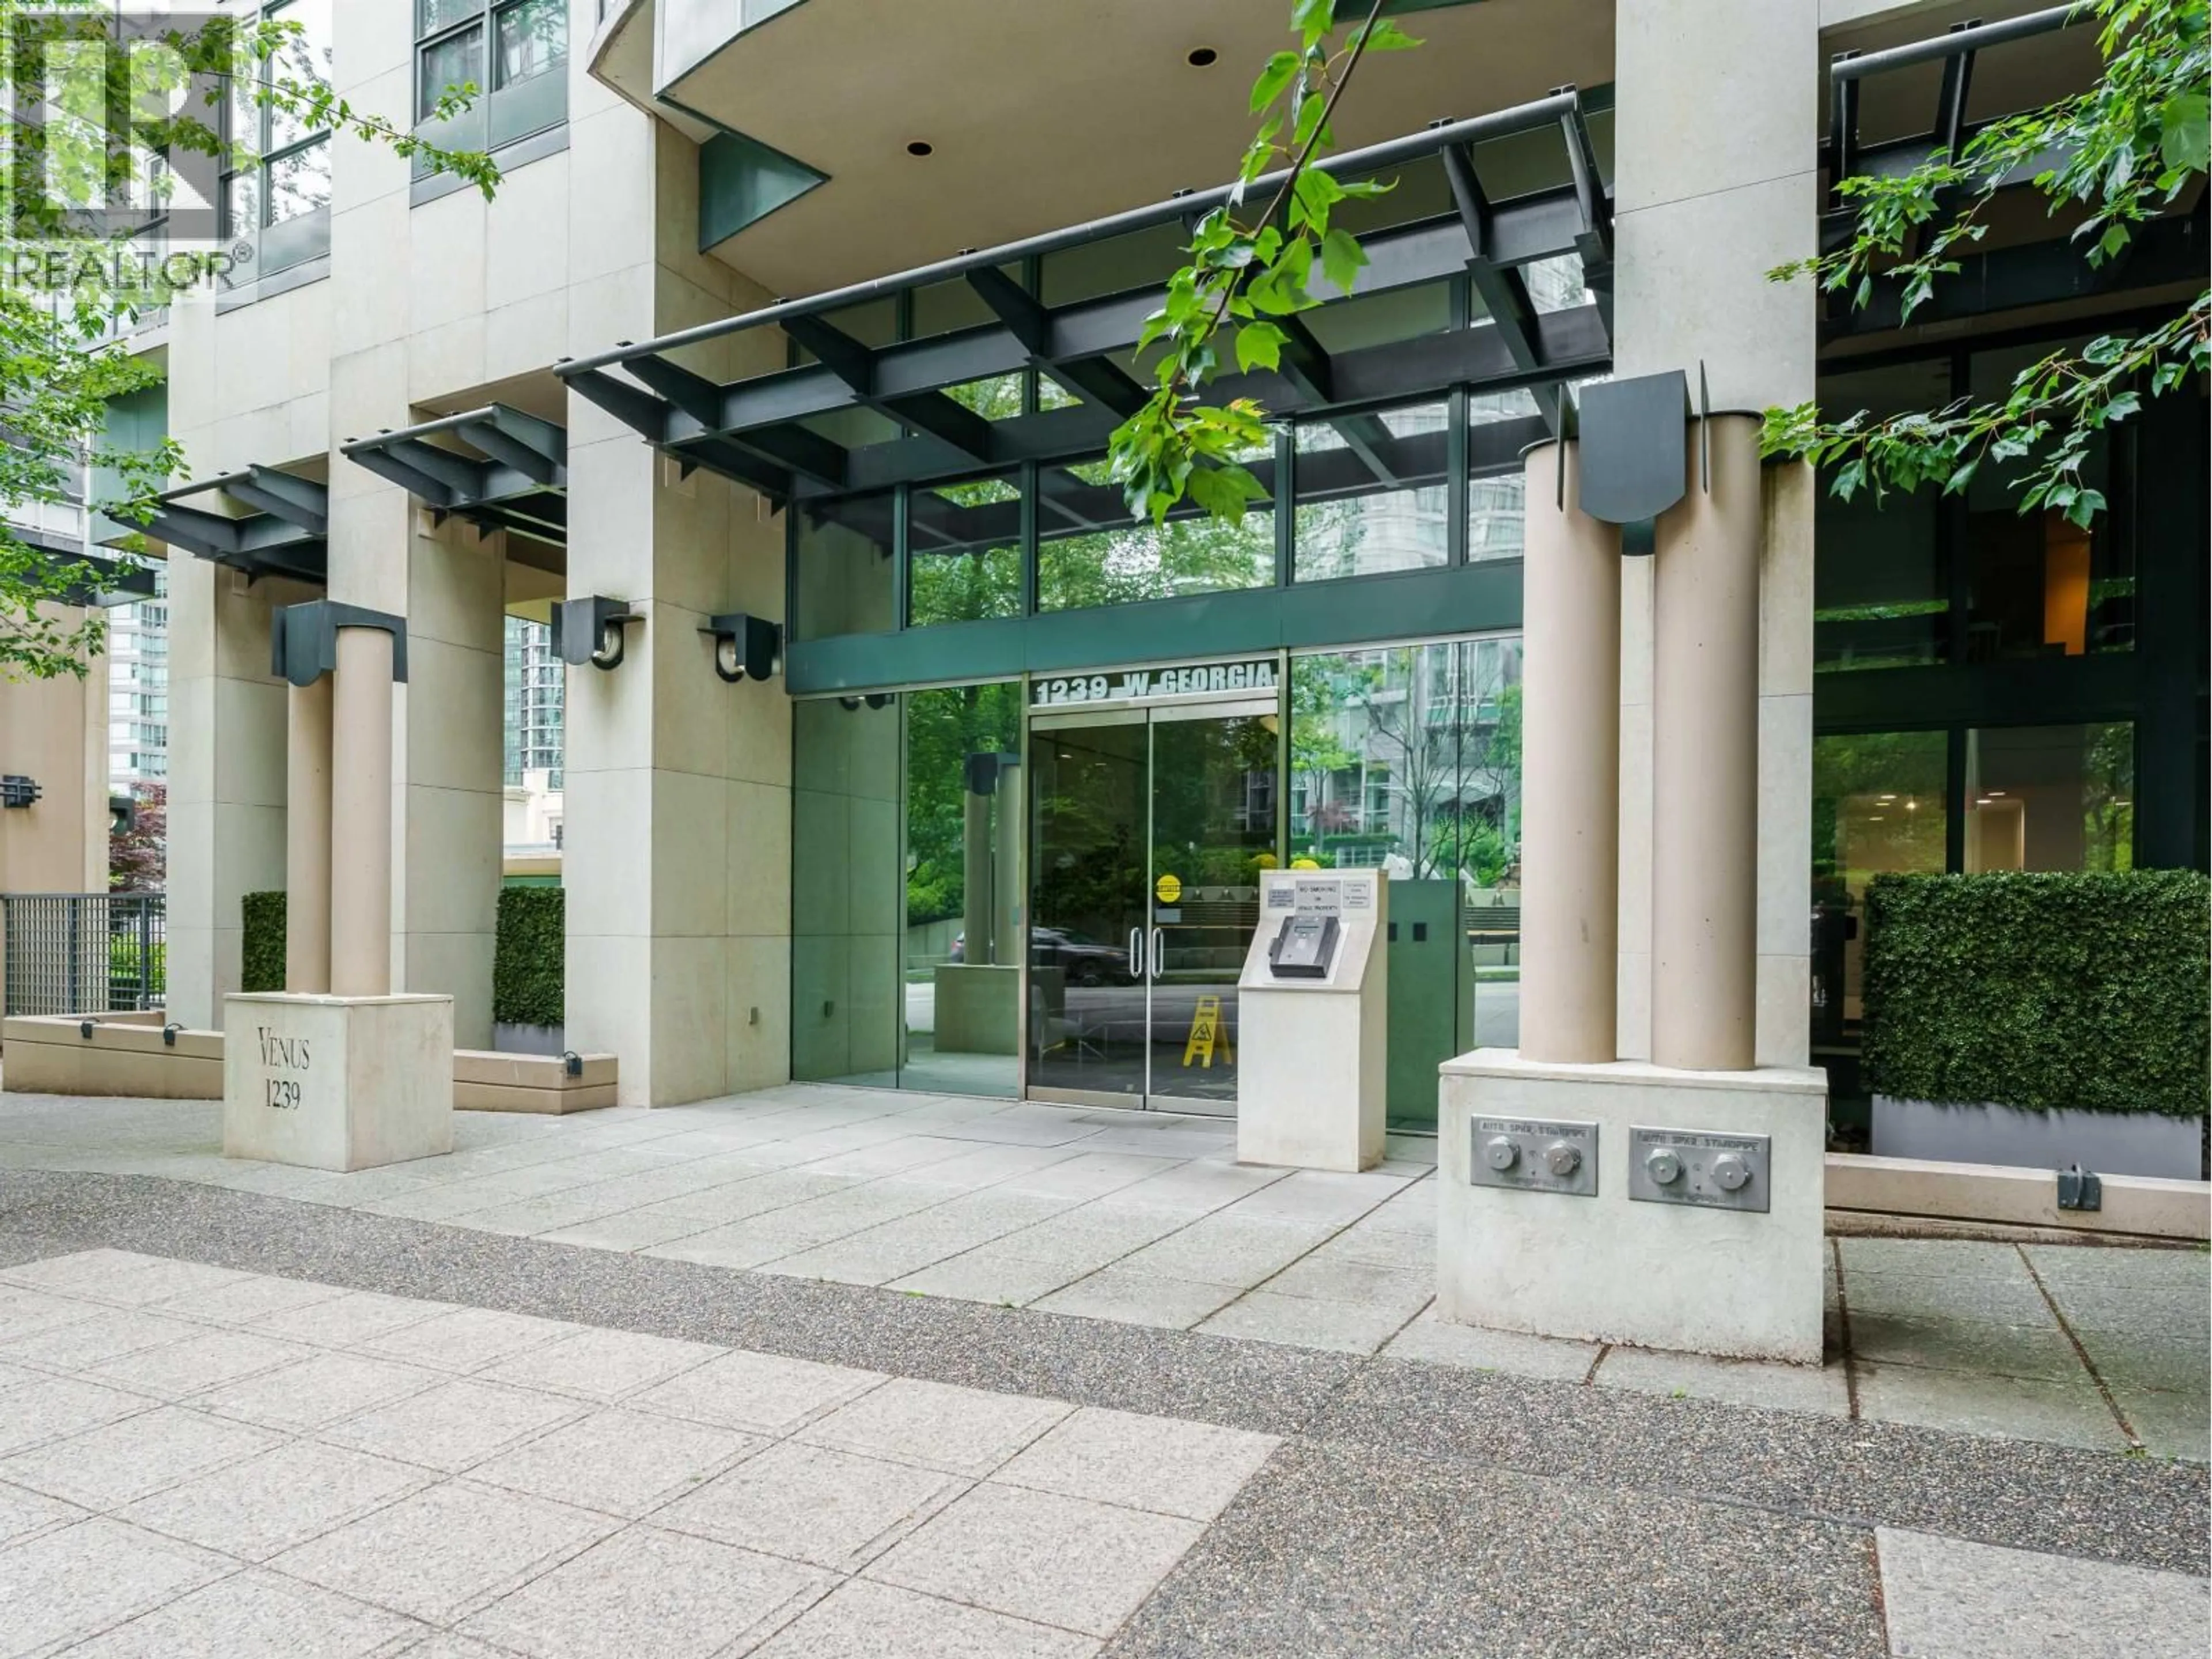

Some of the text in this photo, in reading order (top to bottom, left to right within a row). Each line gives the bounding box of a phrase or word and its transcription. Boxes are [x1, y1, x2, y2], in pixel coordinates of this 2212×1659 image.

[1037, 676, 1108, 704] 1239
[1159, 662, 1272, 692] GEORGIA
[266, 1078, 301, 1110] 1239
